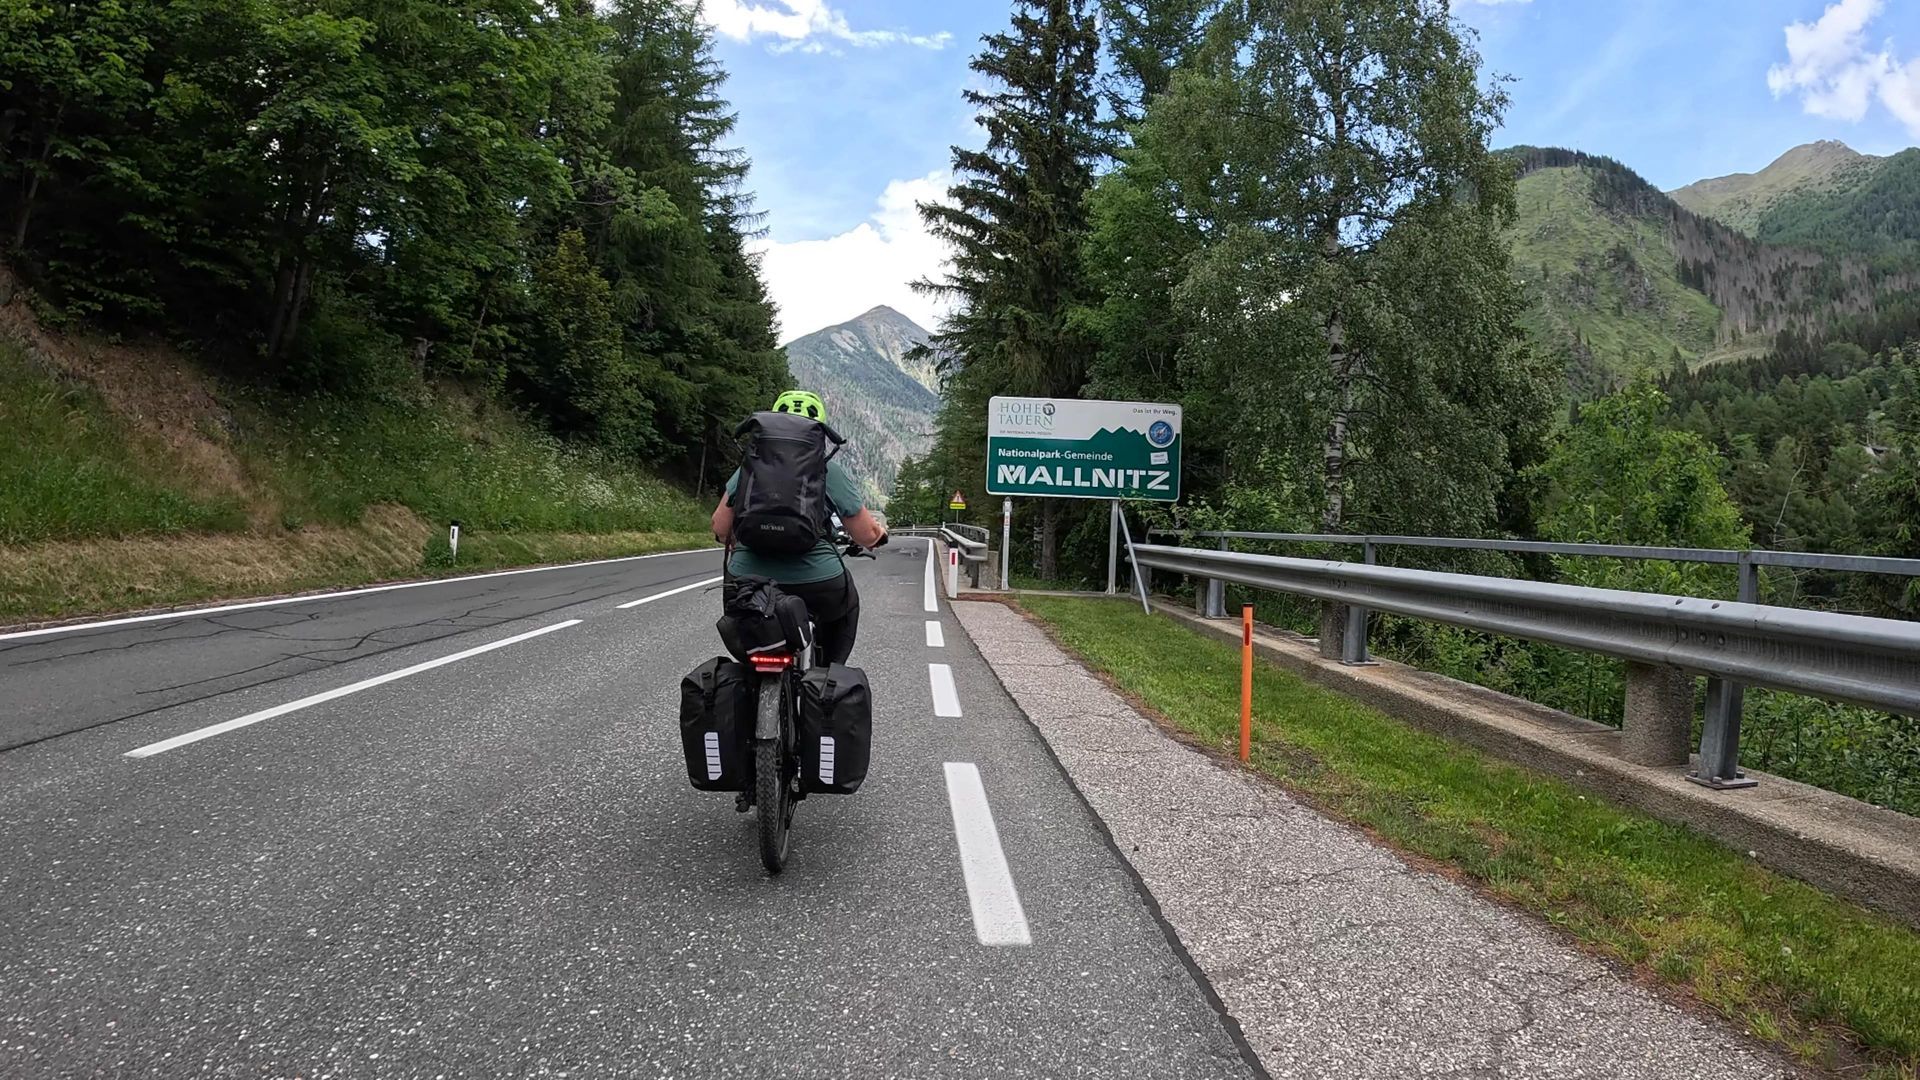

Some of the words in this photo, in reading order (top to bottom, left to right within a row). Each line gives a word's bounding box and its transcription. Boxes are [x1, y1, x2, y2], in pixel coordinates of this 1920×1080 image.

[1000, 402, 1042, 414] HOHE
[998, 413, 1053, 428] TAUERN
[998, 448, 1113, 461] Nationalpark-Gemeinde
[997, 464, 1170, 490] MALLNITZ
